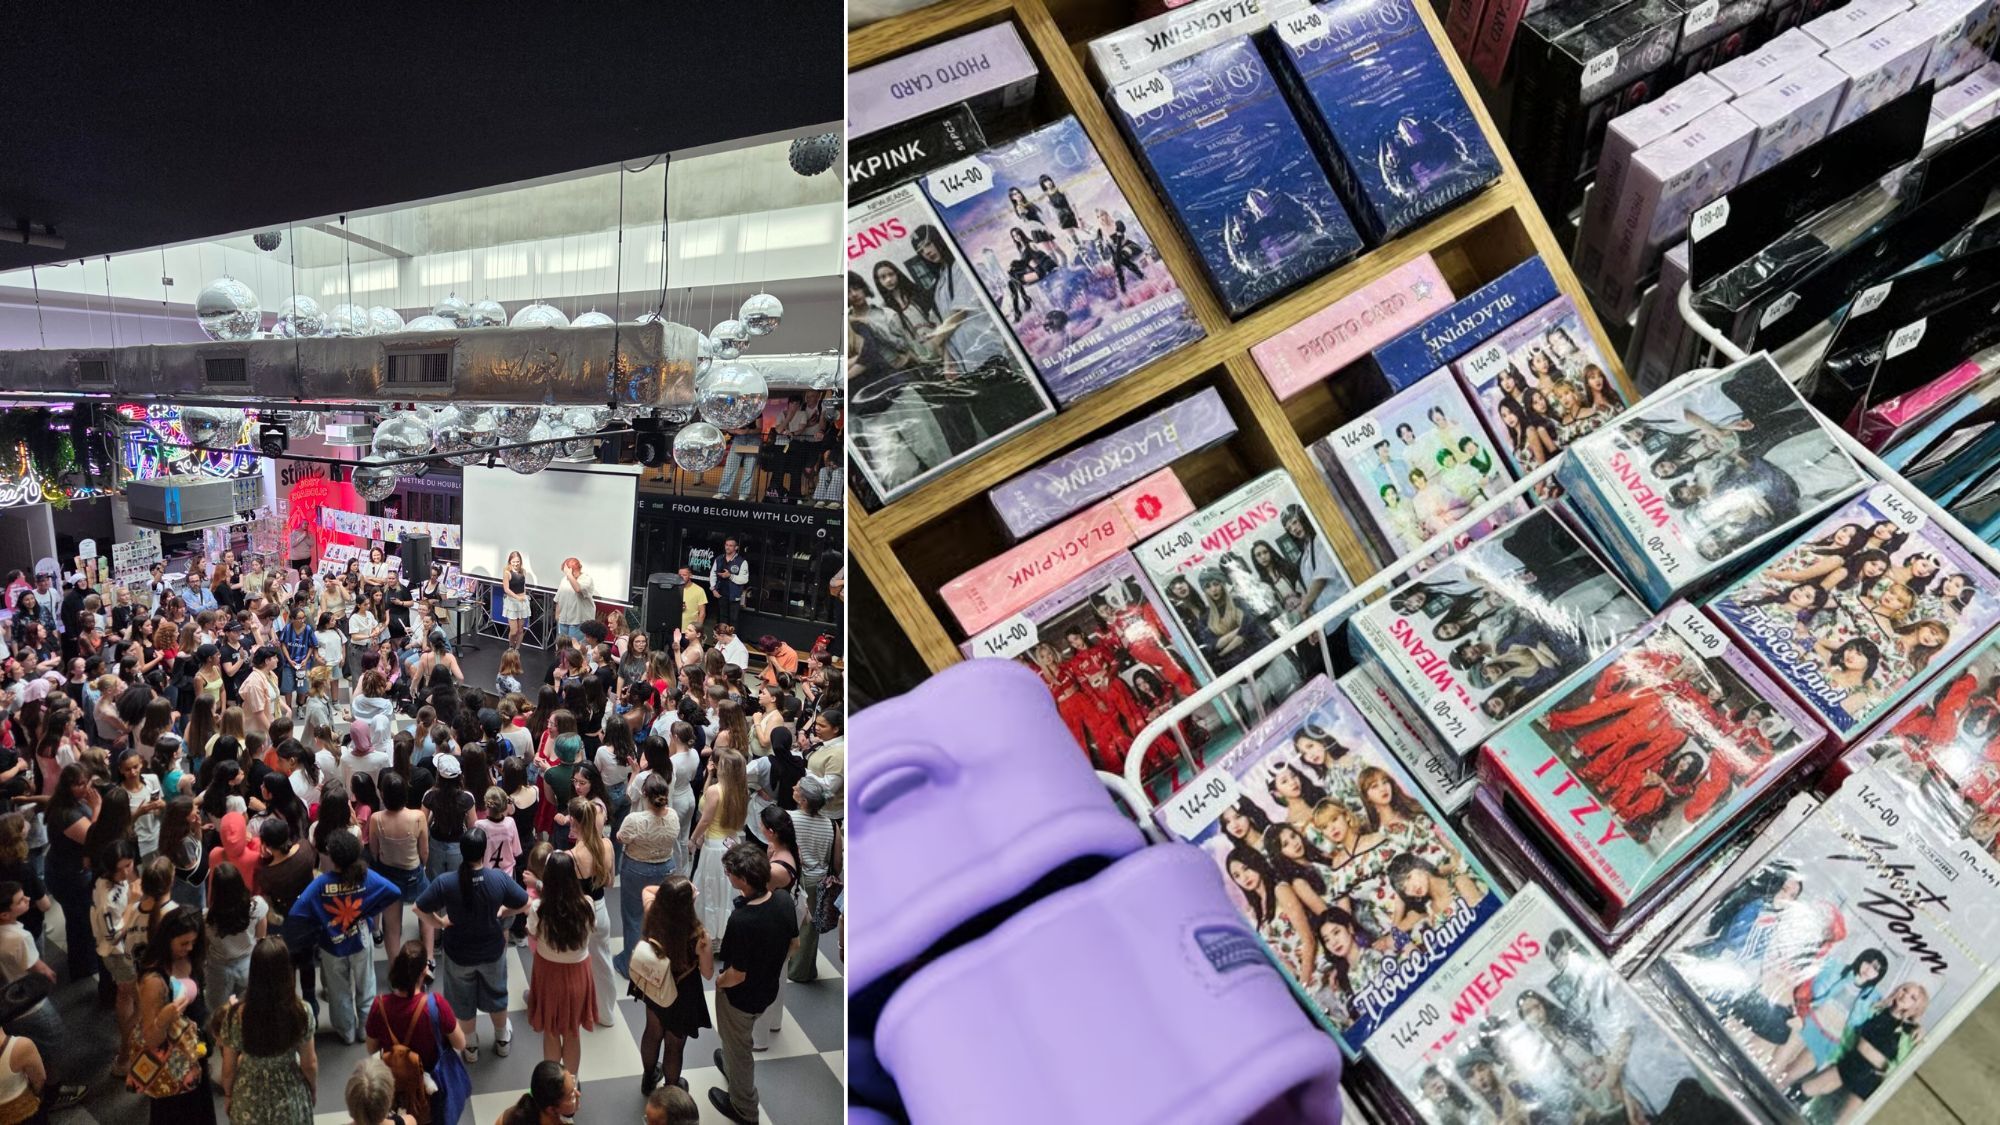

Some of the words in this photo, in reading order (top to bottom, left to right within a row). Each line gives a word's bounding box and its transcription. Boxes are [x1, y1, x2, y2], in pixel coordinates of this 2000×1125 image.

[1146, 0, 1258, 53] BLACKPINK
[1287, 14, 1322, 36] 144-00
[937, 53, 991, 87] PHOTO
[1590, 55, 1615, 75] 144-00
[890, 73, 934, 100] CARD
[1127, 77, 1164, 103] 144-00
[1177, 102, 1210, 122] WORLD
[1210, 94, 1232, 109] TOUR
[847, 139, 927, 187] KPINK
[940, 165, 984, 193] 144-00
[1111, 312, 1141, 334] PUBG
[1142, 293, 1181, 320] MOBILE
[1297, 316, 1361, 364] PHOTO
[1362, 291, 1407, 328] CARD
[1470, 347, 1501, 374] 144-00
[1343, 421, 1377, 449] 144-00
[1051, 422, 1179, 500] BLACKPINK
[402, 477, 425, 485] METTRE
[672, 503, 700, 514] FROM
[703, 506, 749, 519] BELGIUM
[752, 511, 780, 522] WITH
[784, 514, 814, 525] LOVE
[1882, 493, 1919, 526] 144-00
[1006, 520, 1116, 590] BLACKPINK
[1155, 531, 1193, 561] 144-00
[1648, 535, 1681, 574] 144-00
[985, 622, 1028, 656] 144-00
[1681, 614, 1719, 649] 144-00
[1791, 656, 1849, 708] Land
[1433, 700, 1466, 739] 144-00
[1425, 755, 1456, 794] 144-00
[1179, 776, 1227, 821] 144-00
[1531, 757, 1627, 849] ITZY
[1860, 784, 1901, 828] 144-00
[489, 840, 504, 869] 4
[1352, 953, 1429, 1027] Twice
[1423, 897, 1479, 962] Land
[1391, 1002, 1440, 1049] 144-00
